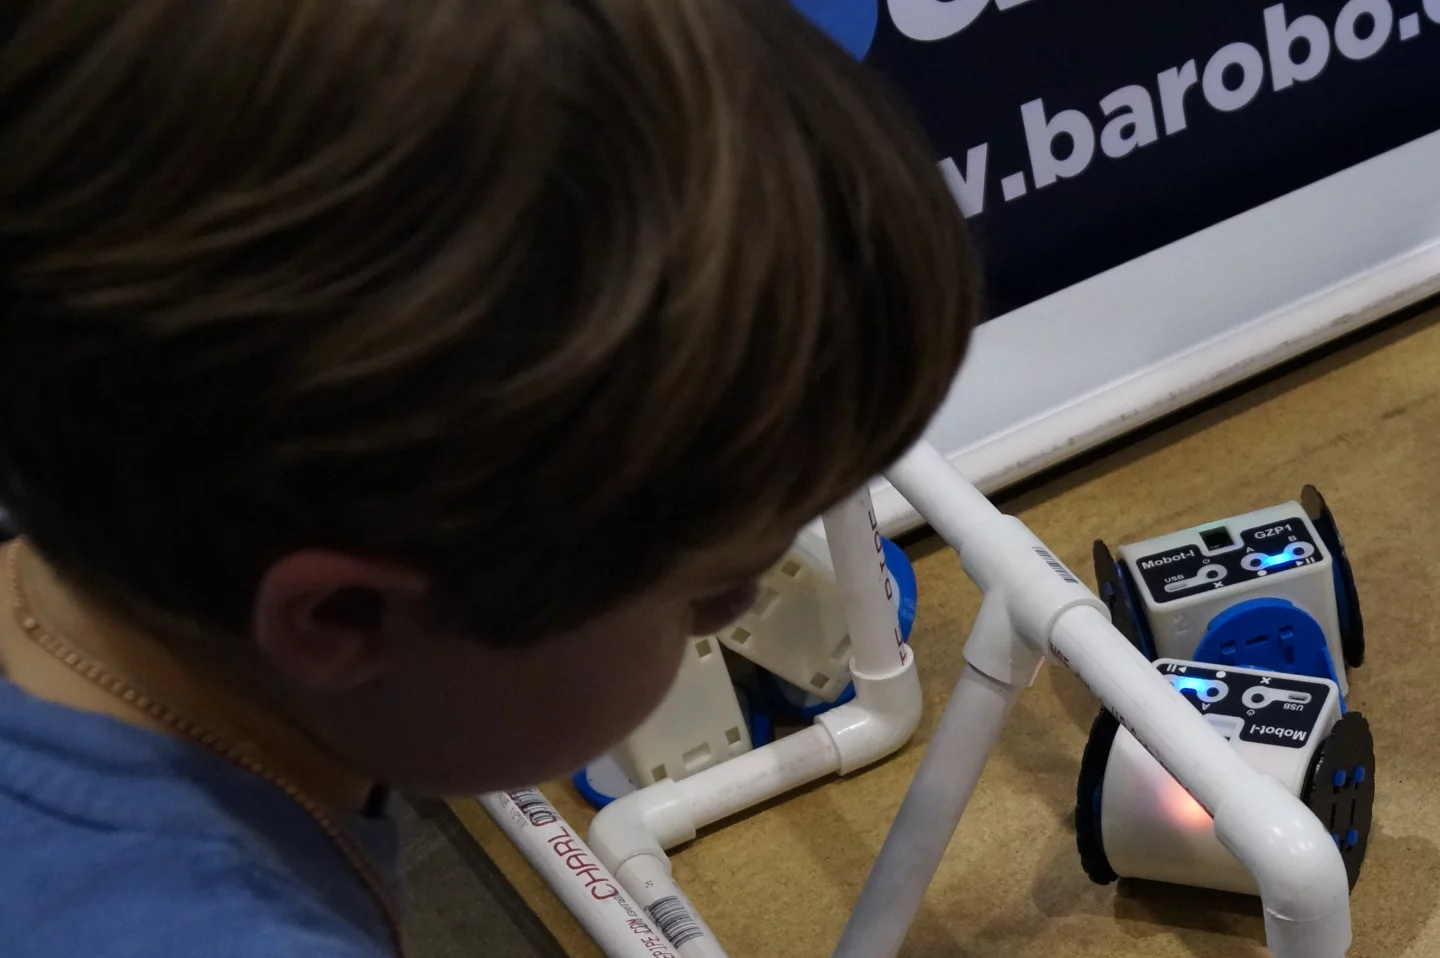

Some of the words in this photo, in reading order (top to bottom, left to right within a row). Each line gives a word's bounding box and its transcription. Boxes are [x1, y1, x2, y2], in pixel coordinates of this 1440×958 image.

[1254, 524, 1292, 540] GZP1
[1164, 574, 1184, 583] USB
[1283, 703, 1304, 712] USB
